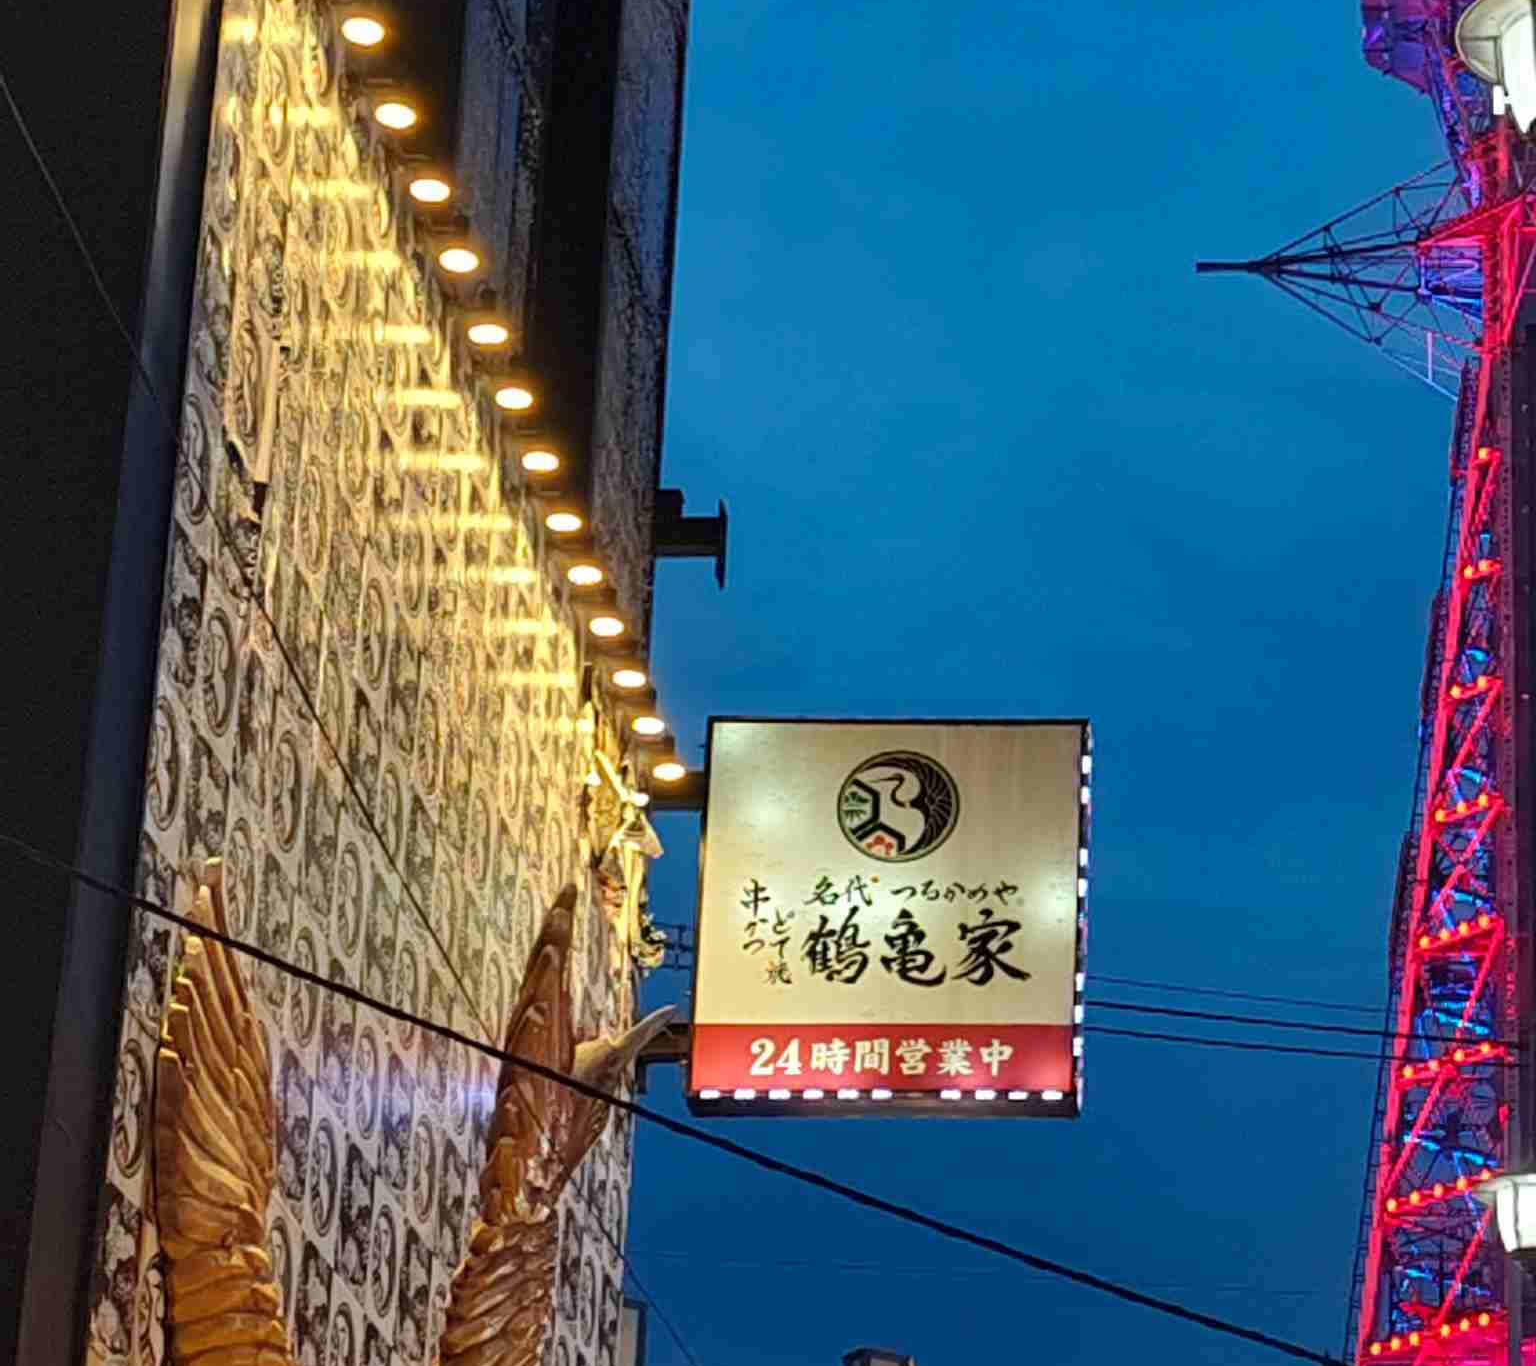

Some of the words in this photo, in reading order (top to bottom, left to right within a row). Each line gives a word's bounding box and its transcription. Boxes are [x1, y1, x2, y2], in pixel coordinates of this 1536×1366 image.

[801, 907, 1031, 988] 鶴亀家
[749, 1038, 1016, 1078] 24時間営業中
